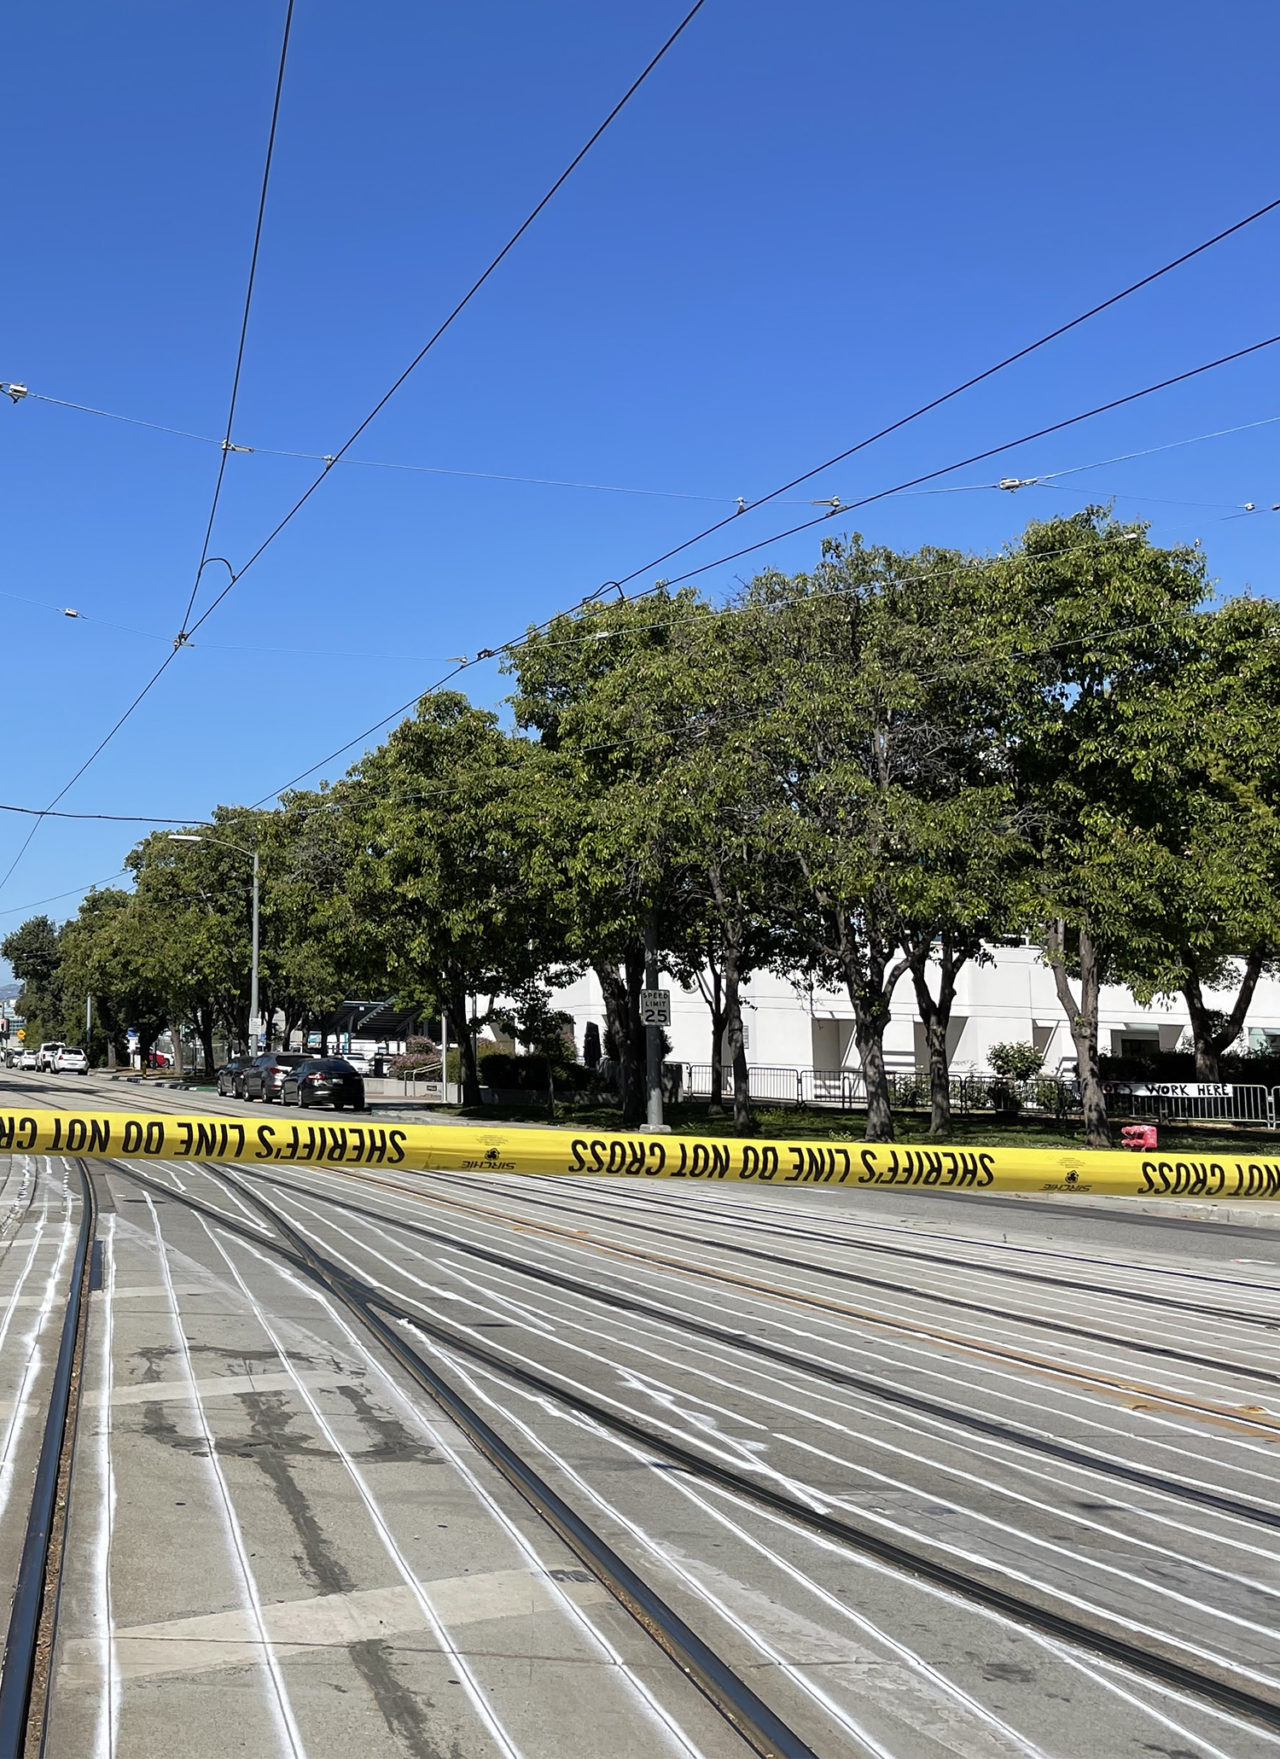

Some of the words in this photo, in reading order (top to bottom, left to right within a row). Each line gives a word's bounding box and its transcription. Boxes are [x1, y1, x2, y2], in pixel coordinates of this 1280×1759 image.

[644, 1009, 668, 1023] 25
[1144, 1084, 1190, 1096] WORK
[1197, 1083, 1230, 1096] HERE
[45, 1118, 111, 1153] NOT
[121, 1121, 165, 1155] DO
[173, 1122, 245, 1158] LINE
[254, 1125, 407, 1164] SHERIFF'S
[567, 1138, 666, 1175] CROSS
[669, 1143, 731, 1178] NOT
[738, 1145, 779, 1180] DO
[783, 1147, 851, 1183] LINE
[857, 1150, 996, 1188] SHERIFF'S
[1137, 1161, 1226, 1196] CROSS
[1226, 1164, 1280, 1197] NOT
